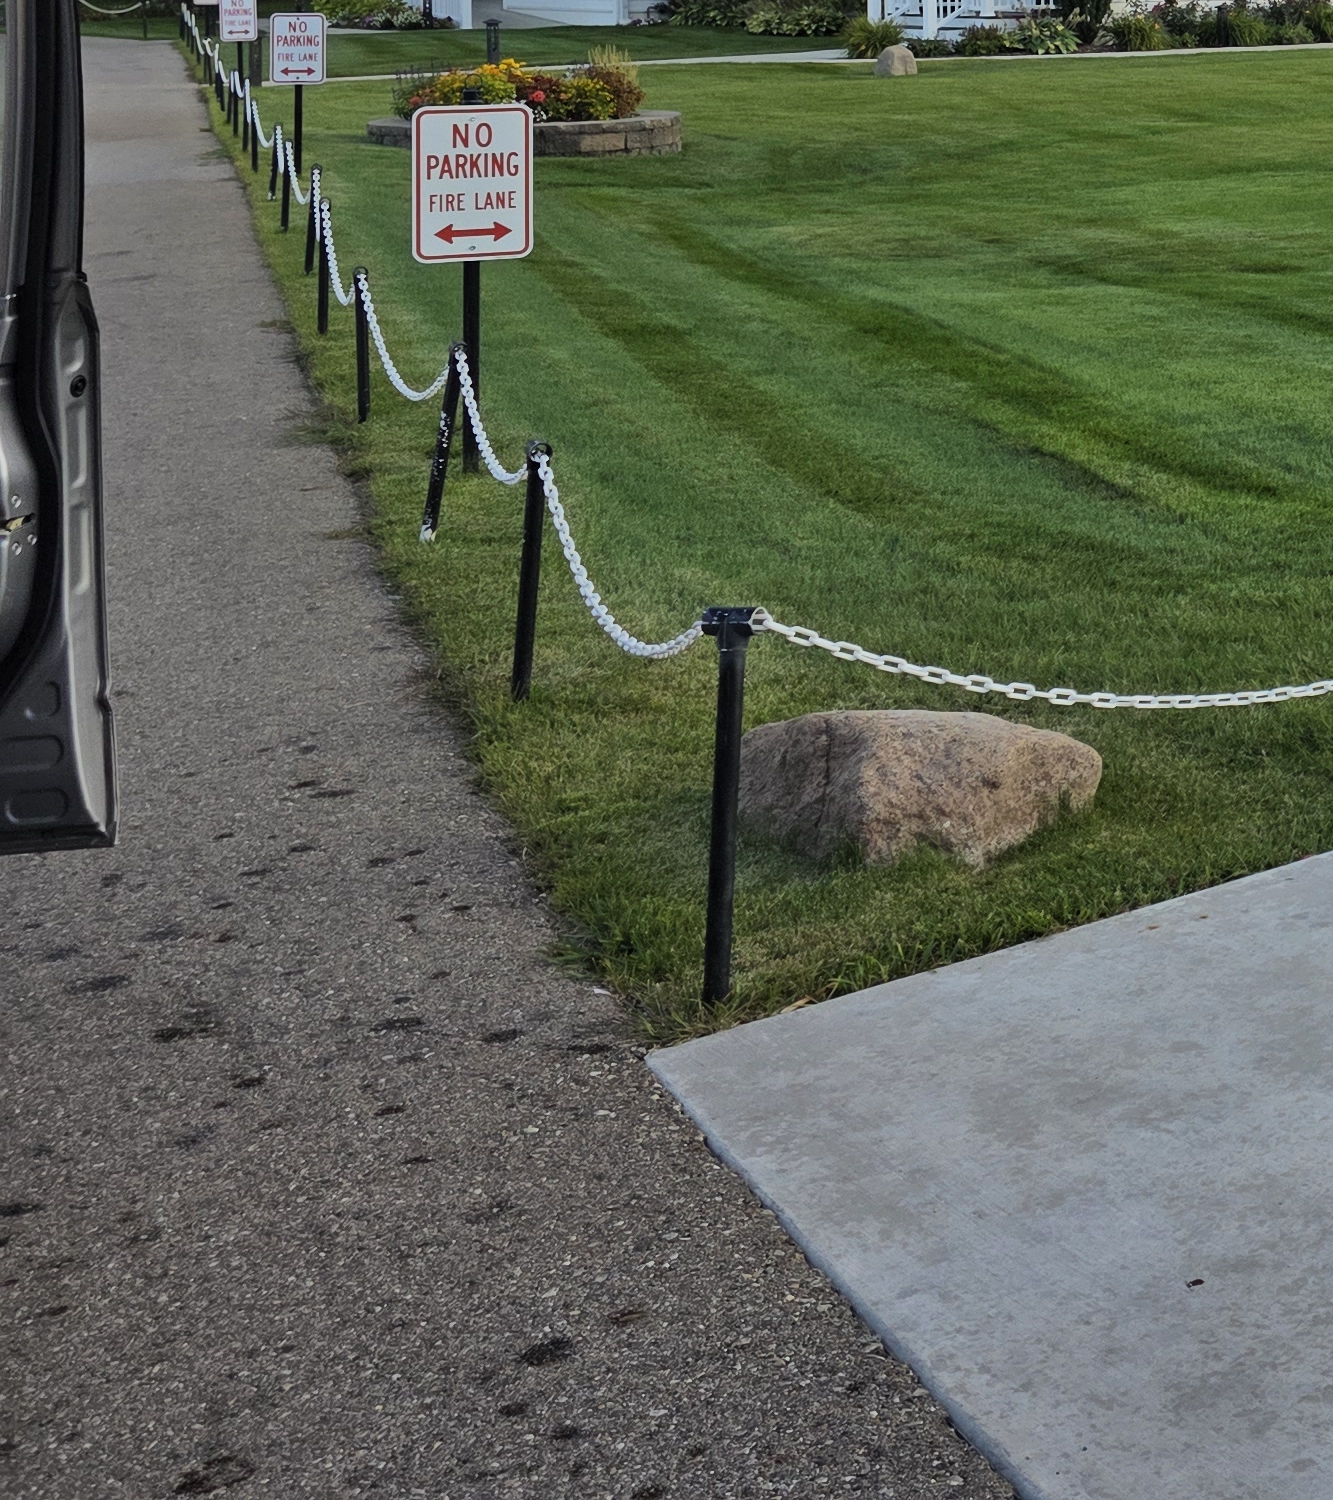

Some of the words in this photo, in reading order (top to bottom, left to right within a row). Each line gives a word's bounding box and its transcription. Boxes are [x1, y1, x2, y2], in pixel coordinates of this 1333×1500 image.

[231, 0, 244, 7] NO
[224, 8, 252, 16] PARKING
[288, 21, 308, 33] NO
[276, 35, 320, 47] PARKING
[277, 52, 295, 62] FIRE
[298, 52, 318, 62] LANE
[452, 123, 493, 149] NO
[426, 152, 519, 180] PARKING
[429, 193, 466, 212] FIRE
[475, 191, 517, 210] LANE
